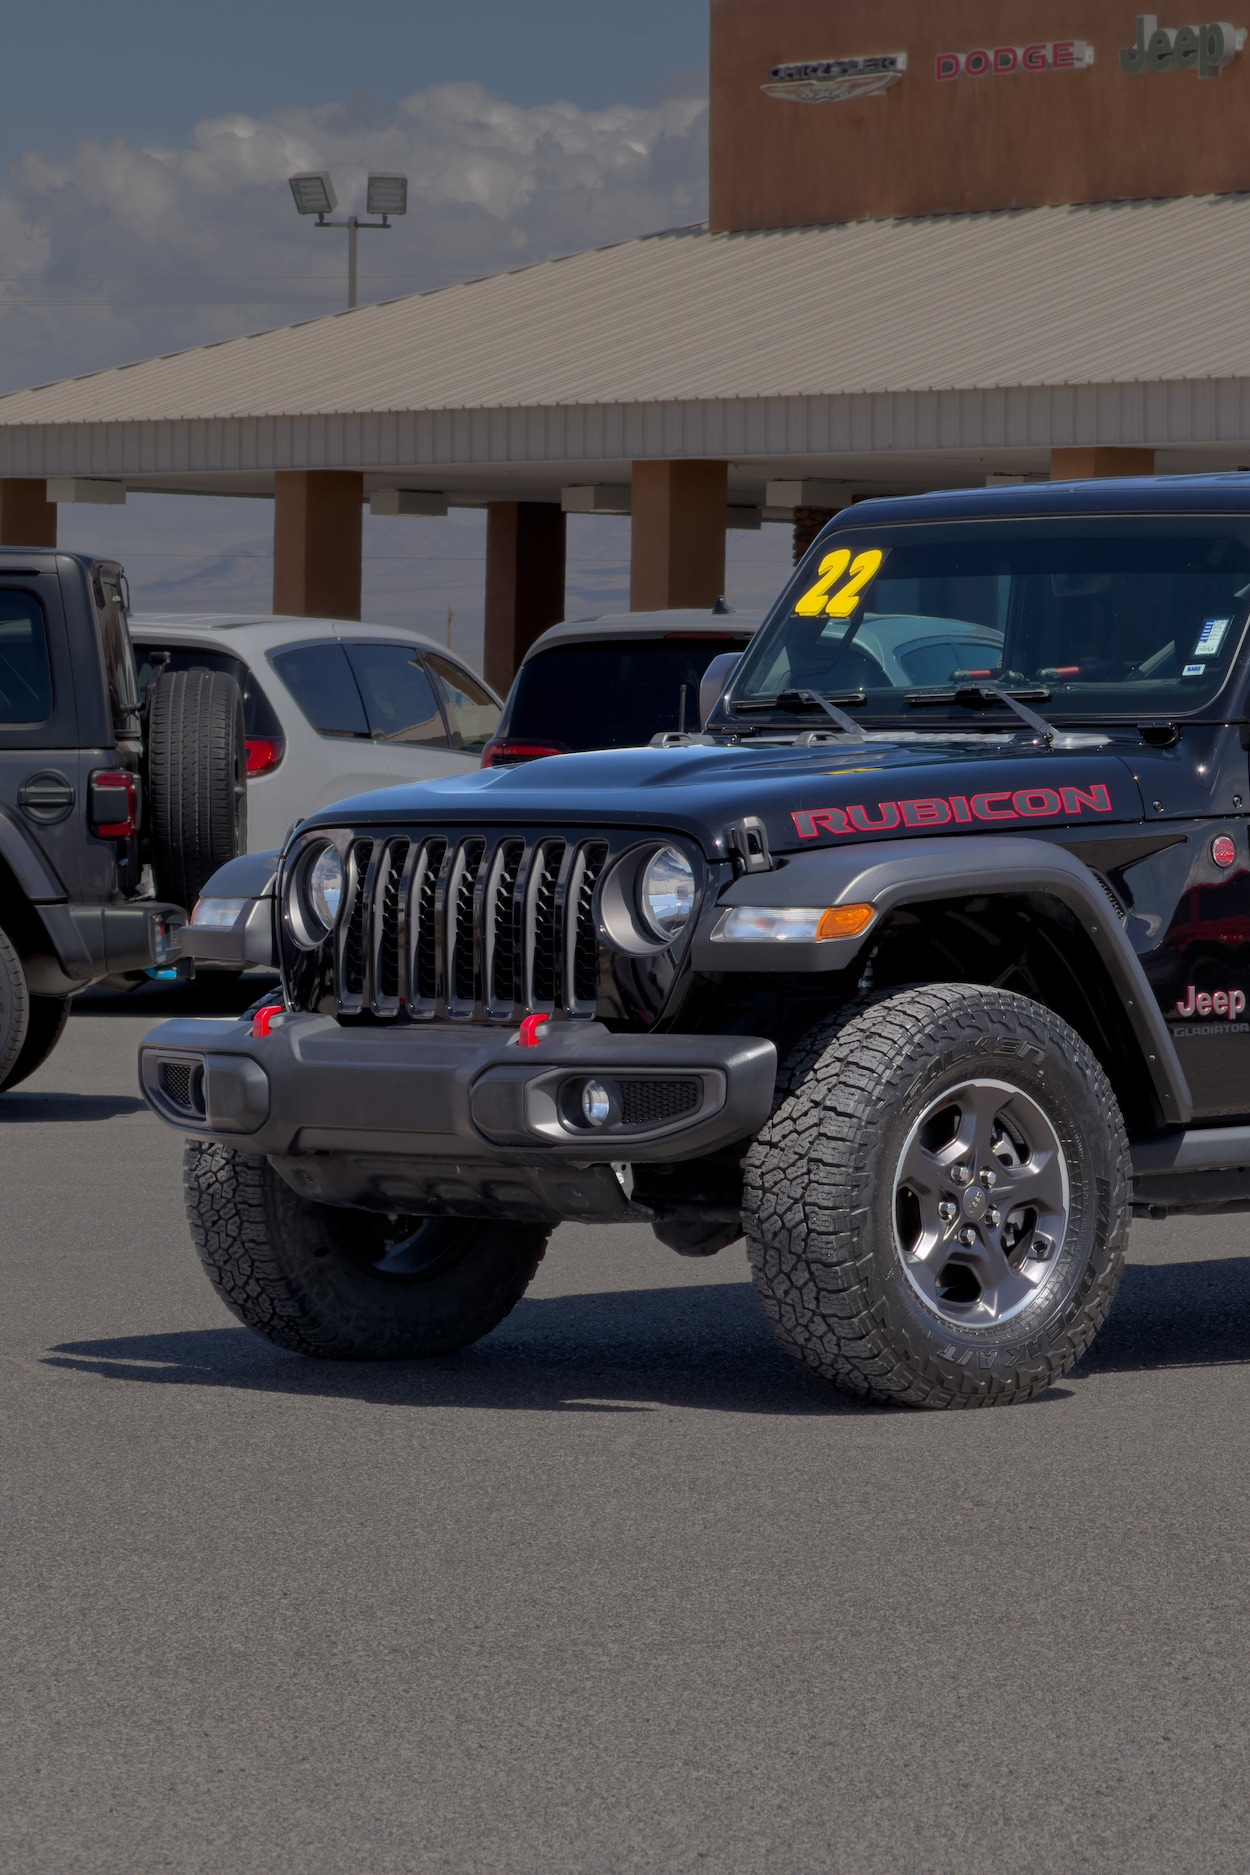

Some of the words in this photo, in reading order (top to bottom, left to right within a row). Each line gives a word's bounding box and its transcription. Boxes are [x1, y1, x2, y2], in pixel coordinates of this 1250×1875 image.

[769, 54, 899, 80] CHRYSLER
[935, 41, 1077, 81] DODGE
[1119, 15, 1228, 79] Jeep
[794, 548, 882, 617] 22
[790, 783, 1113, 839] RUBICON
[1173, 1022, 1250, 1038] GLADIATOR
[1175, 985, 1246, 1020] Jeep
[899, 1036, 1048, 1116] FALKEN
[1004, 1175, 1113, 1367] WILDPEAK
